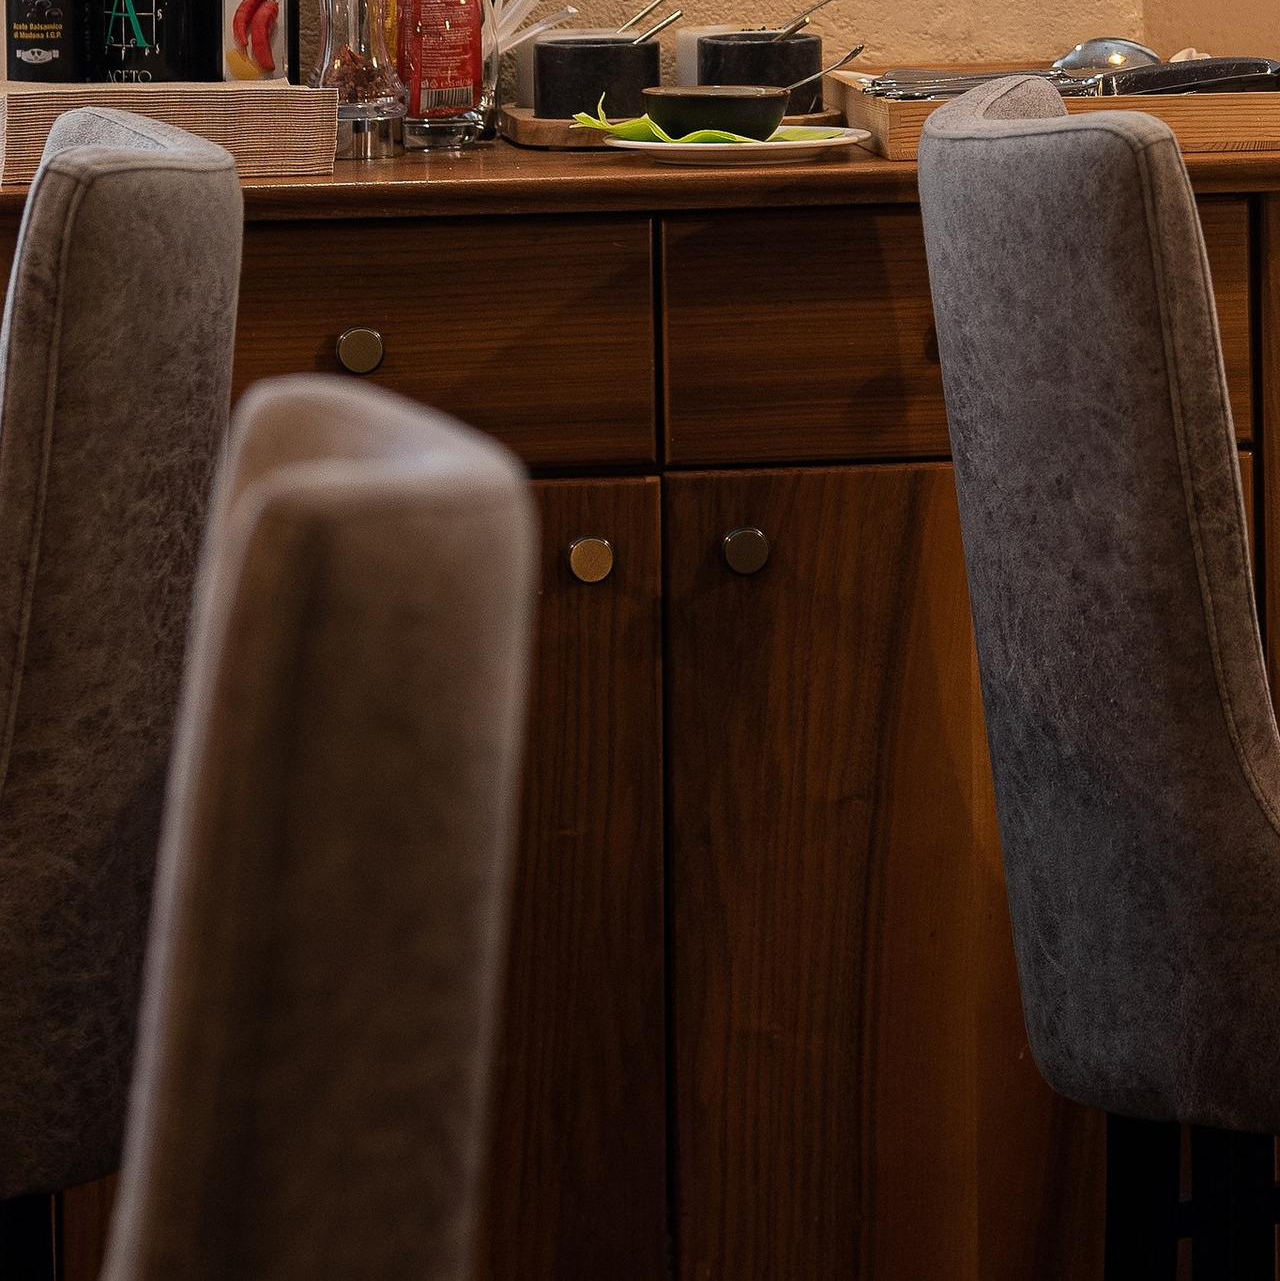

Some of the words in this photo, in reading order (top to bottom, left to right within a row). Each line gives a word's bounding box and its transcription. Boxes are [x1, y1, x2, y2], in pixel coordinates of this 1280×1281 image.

[29, 23, 63, 31] Balsamico
[19, 31, 45, 39] Modena
[107, 70, 153, 83] ACETO
